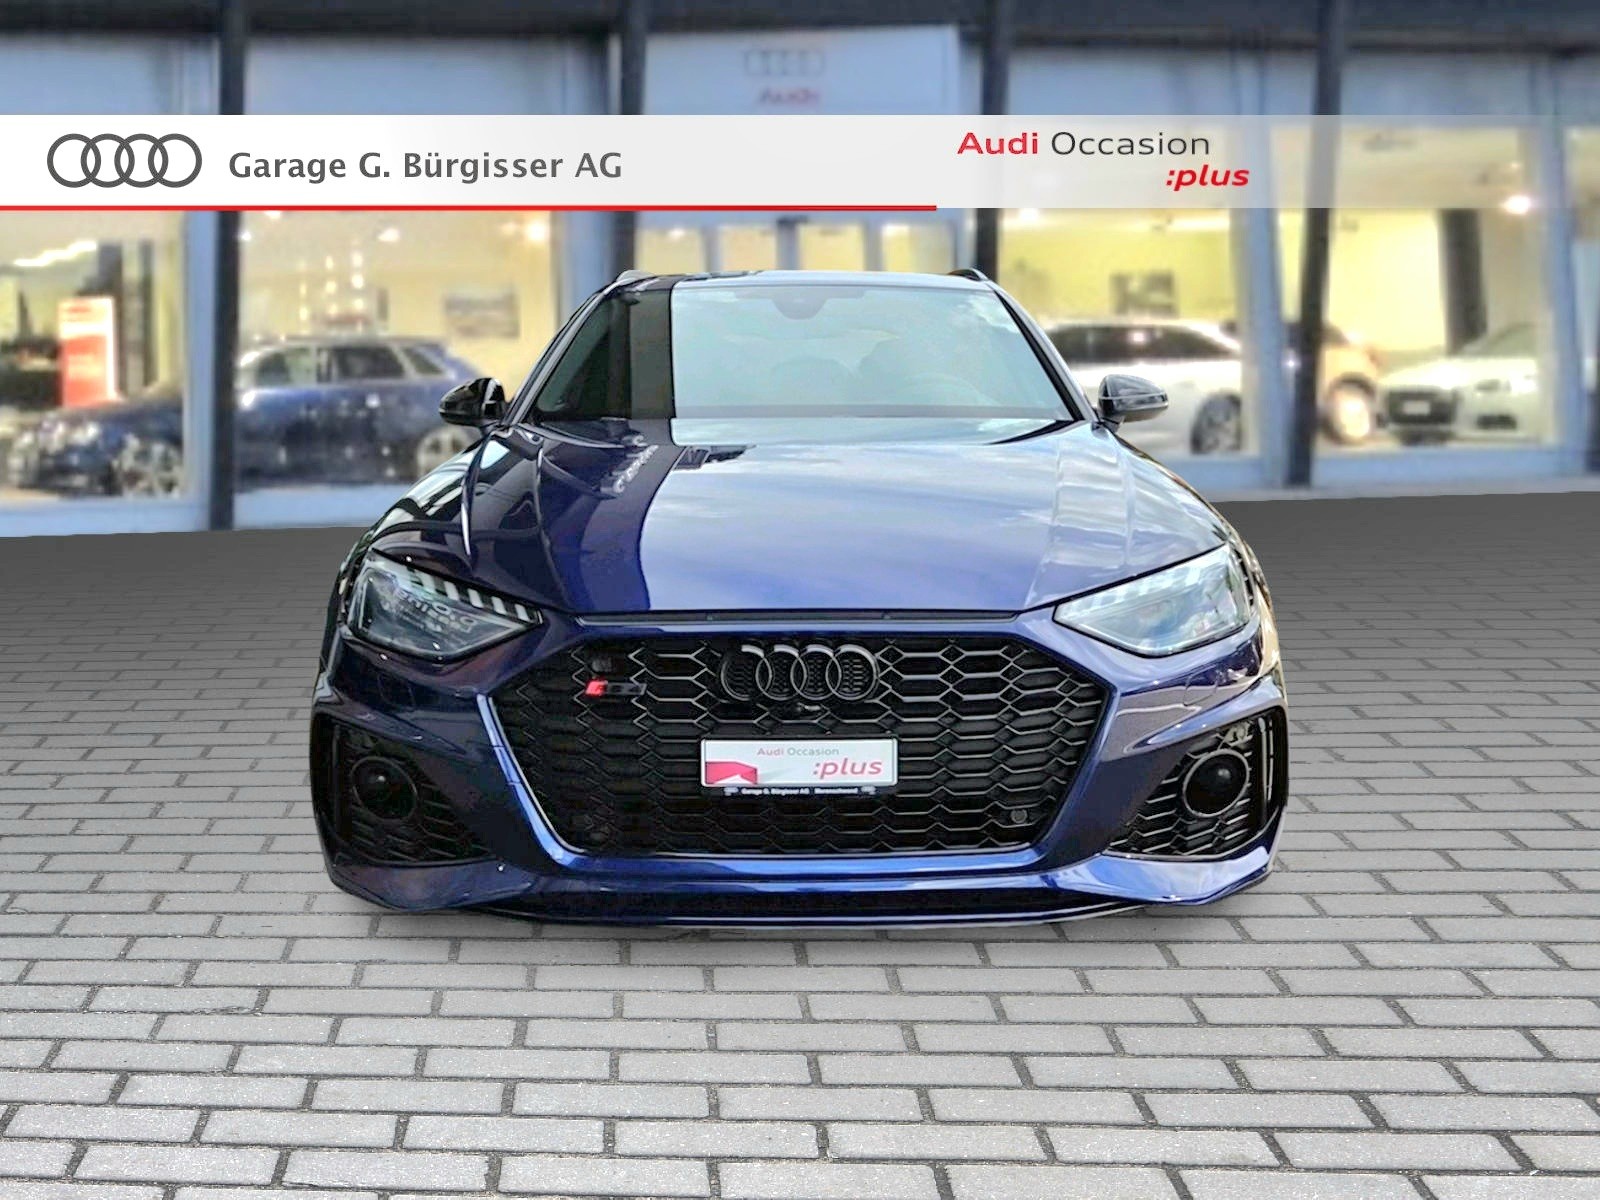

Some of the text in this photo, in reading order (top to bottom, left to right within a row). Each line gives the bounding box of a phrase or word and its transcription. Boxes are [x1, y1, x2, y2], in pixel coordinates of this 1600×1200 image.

[757, 747, 839, 757] Audi Occasion
[813, 757, 883, 780] :plus
